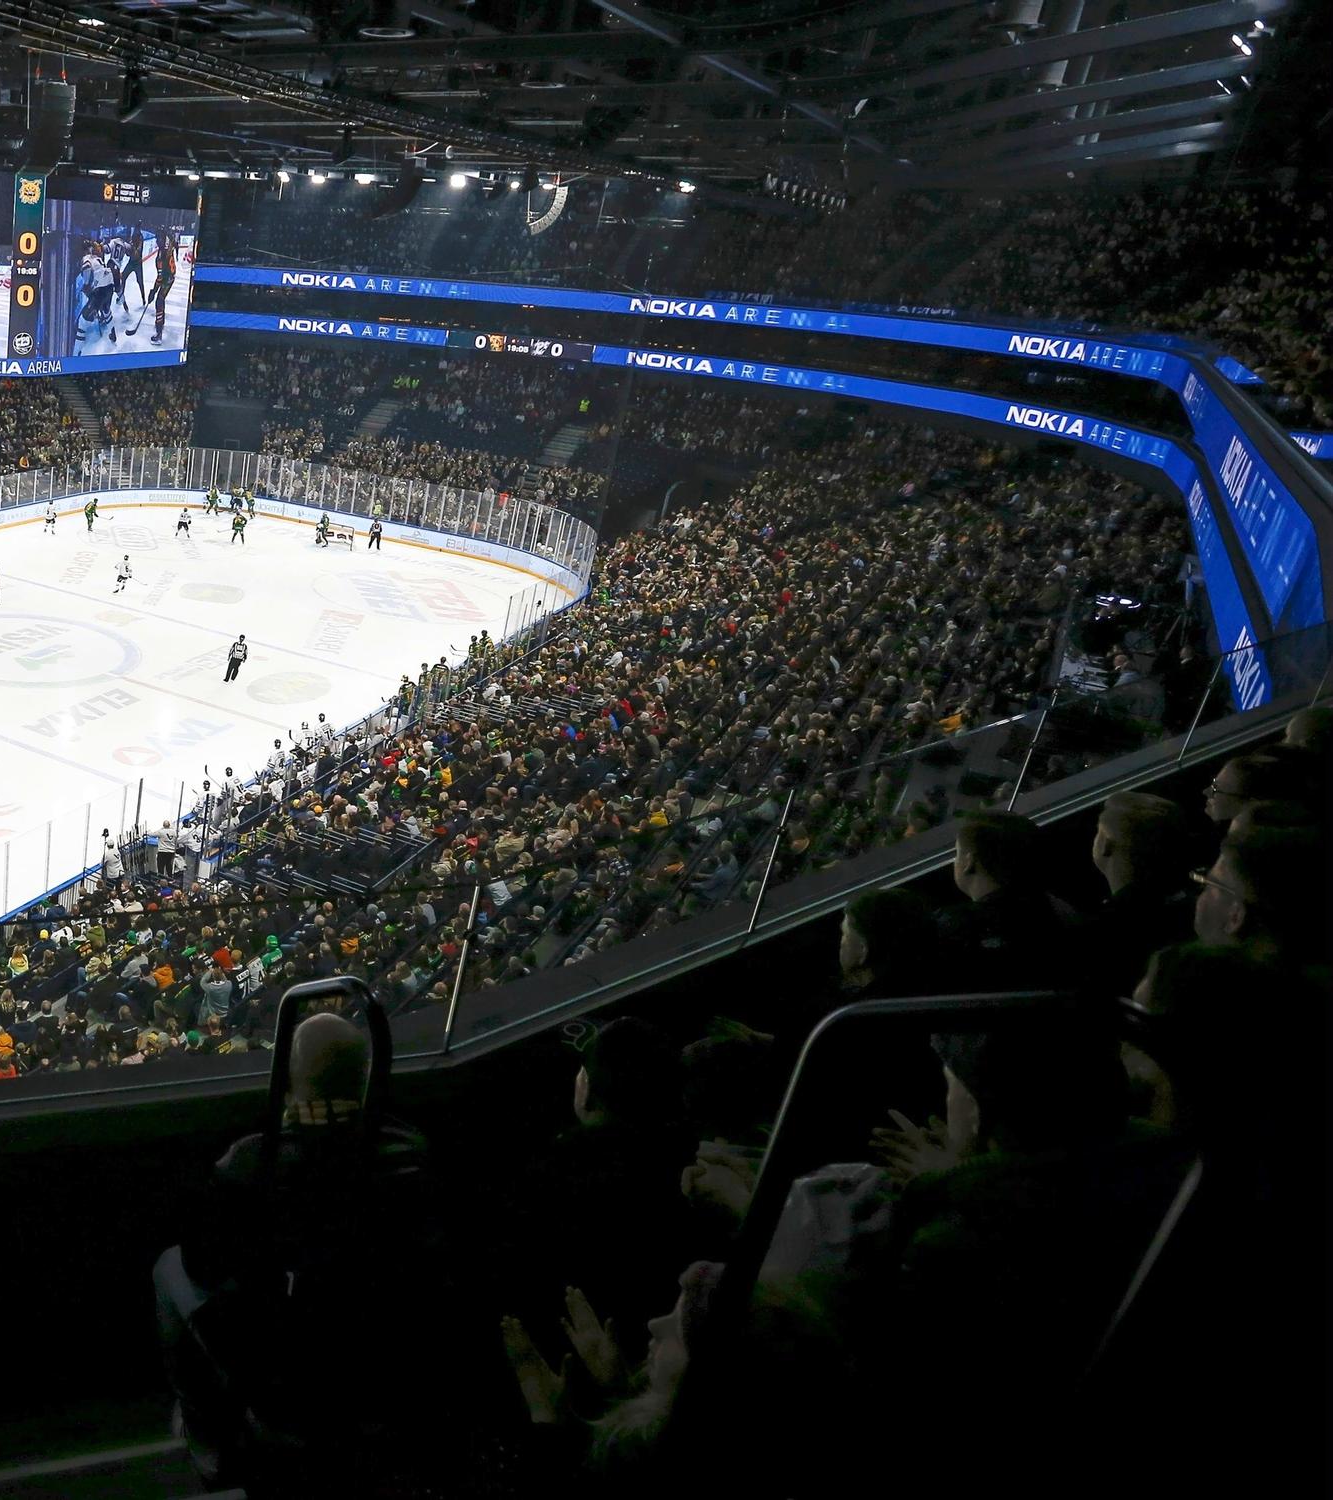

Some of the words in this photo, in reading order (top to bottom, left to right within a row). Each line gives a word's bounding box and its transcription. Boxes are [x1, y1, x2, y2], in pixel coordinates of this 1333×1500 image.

[19, 231, 38, 255] 0
[16, 266, 38, 275] 19:05
[282, 272, 356, 290] NOKIA
[16, 284, 34, 307] 0
[630, 298, 715, 319] NOKIA
[279, 318, 353, 336] NOKIA
[475, 335, 486, 349] 0
[507, 343, 529, 354] 19:05
[551, 343, 563, 357] 0
[1008, 335, 1085, 361] NOKIA
[27, 360, 62, 375] ARENA
[627, 351, 713, 373] NOKIA
[1006, 405, 1084, 438] NOKIA
